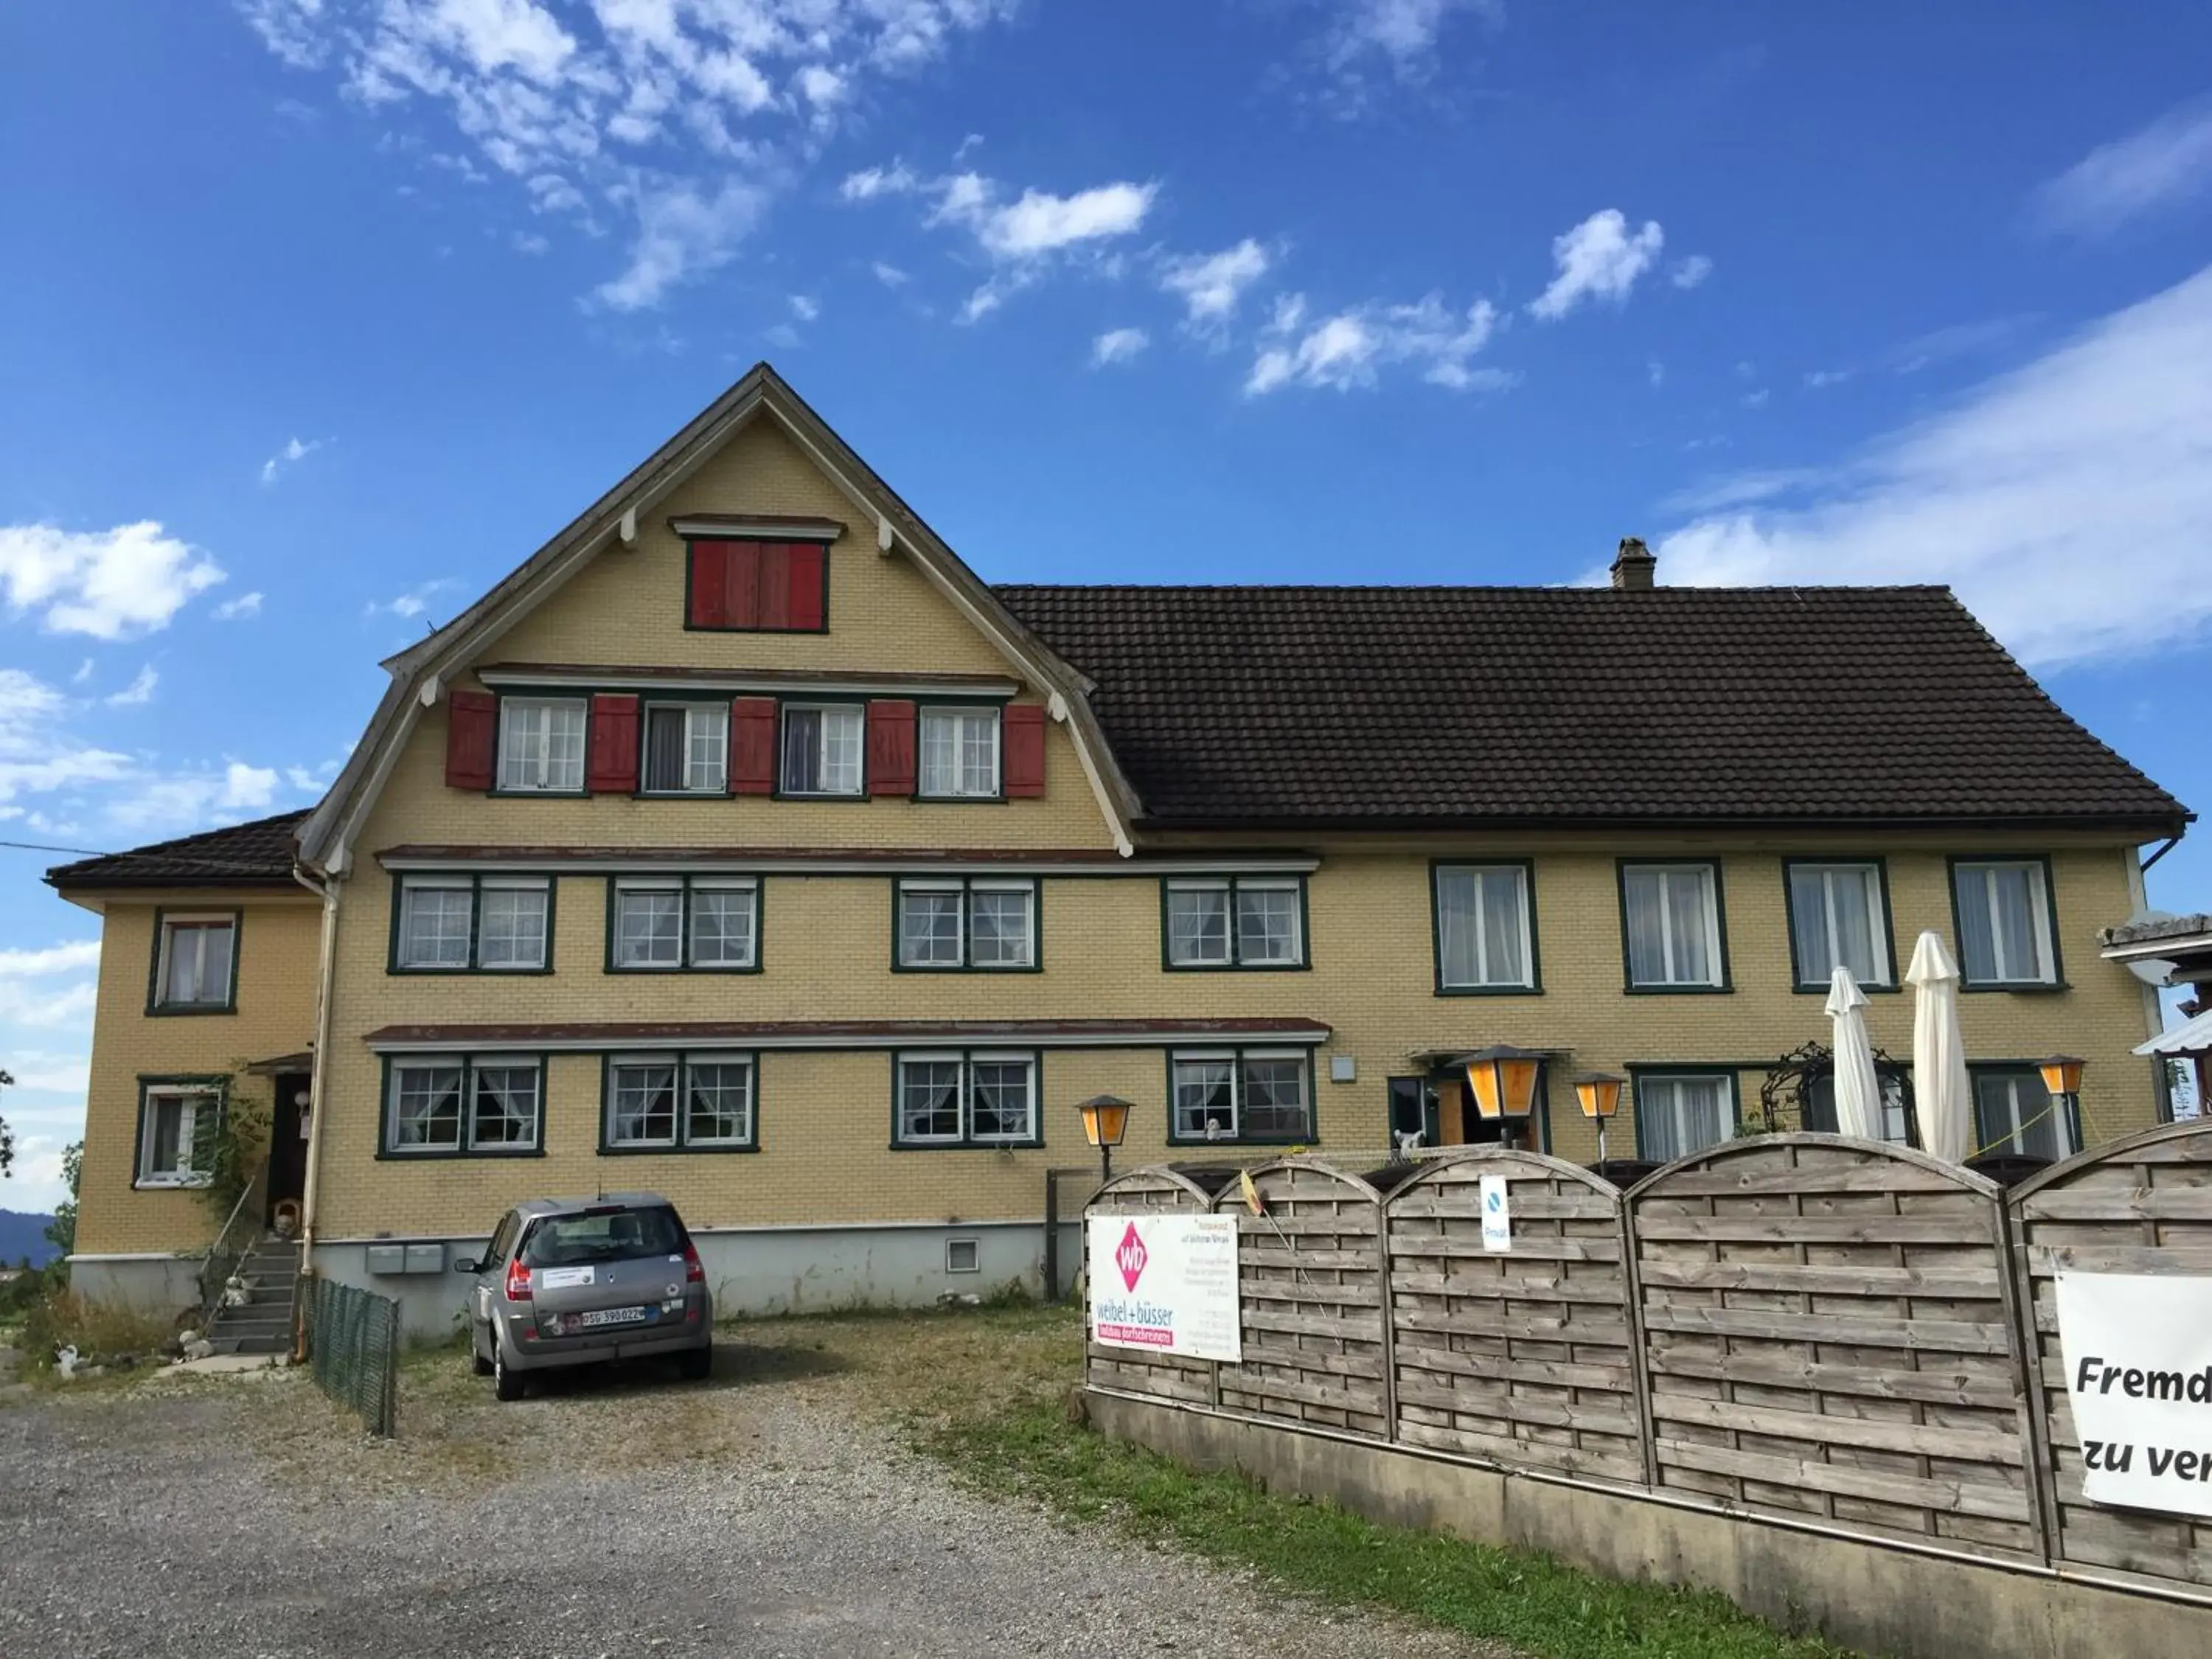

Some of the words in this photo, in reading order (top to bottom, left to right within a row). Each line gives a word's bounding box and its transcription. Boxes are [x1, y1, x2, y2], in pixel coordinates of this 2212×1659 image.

[1120, 1237, 1144, 1270] wb
[2076, 1357, 2212, 1404] Fremd
[2084, 1440, 2133, 1473] zu
